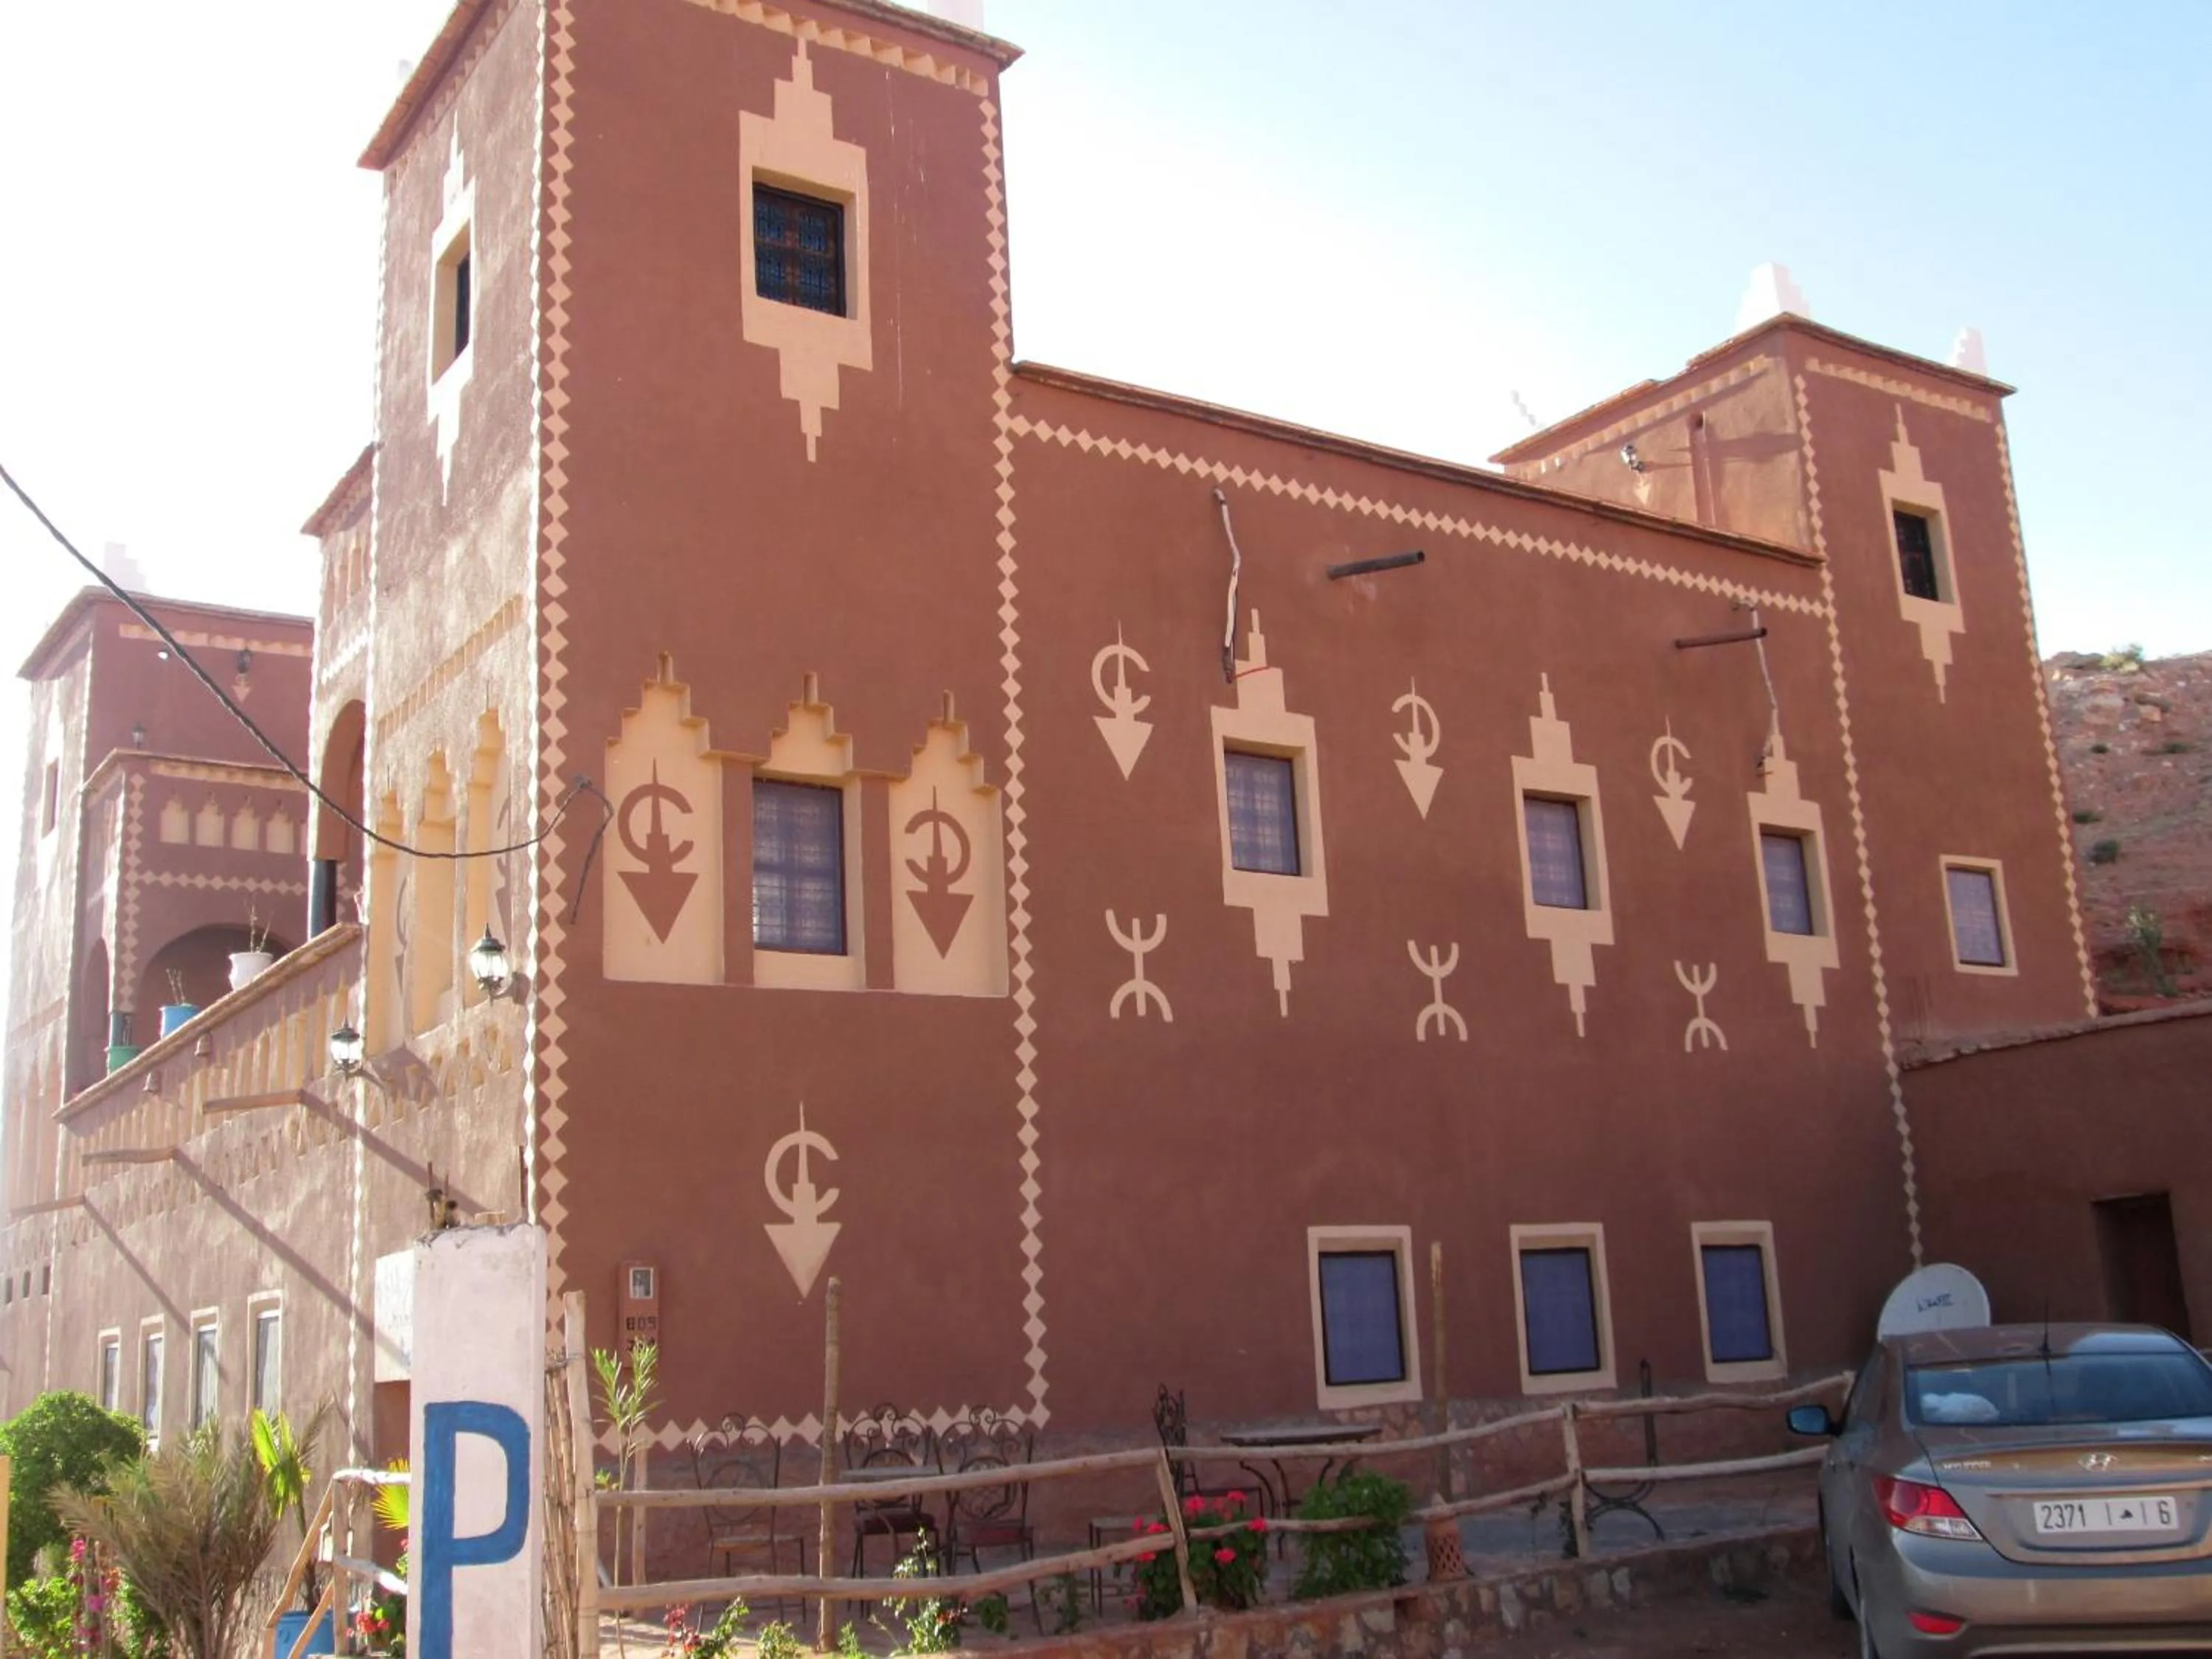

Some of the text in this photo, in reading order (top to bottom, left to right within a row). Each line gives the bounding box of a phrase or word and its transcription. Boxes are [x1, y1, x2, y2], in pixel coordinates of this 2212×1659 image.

[418, 1401, 531, 1659] P
[2041, 1503, 2086, 1529] 2371
[2157, 1500, 2171, 1526] 6
